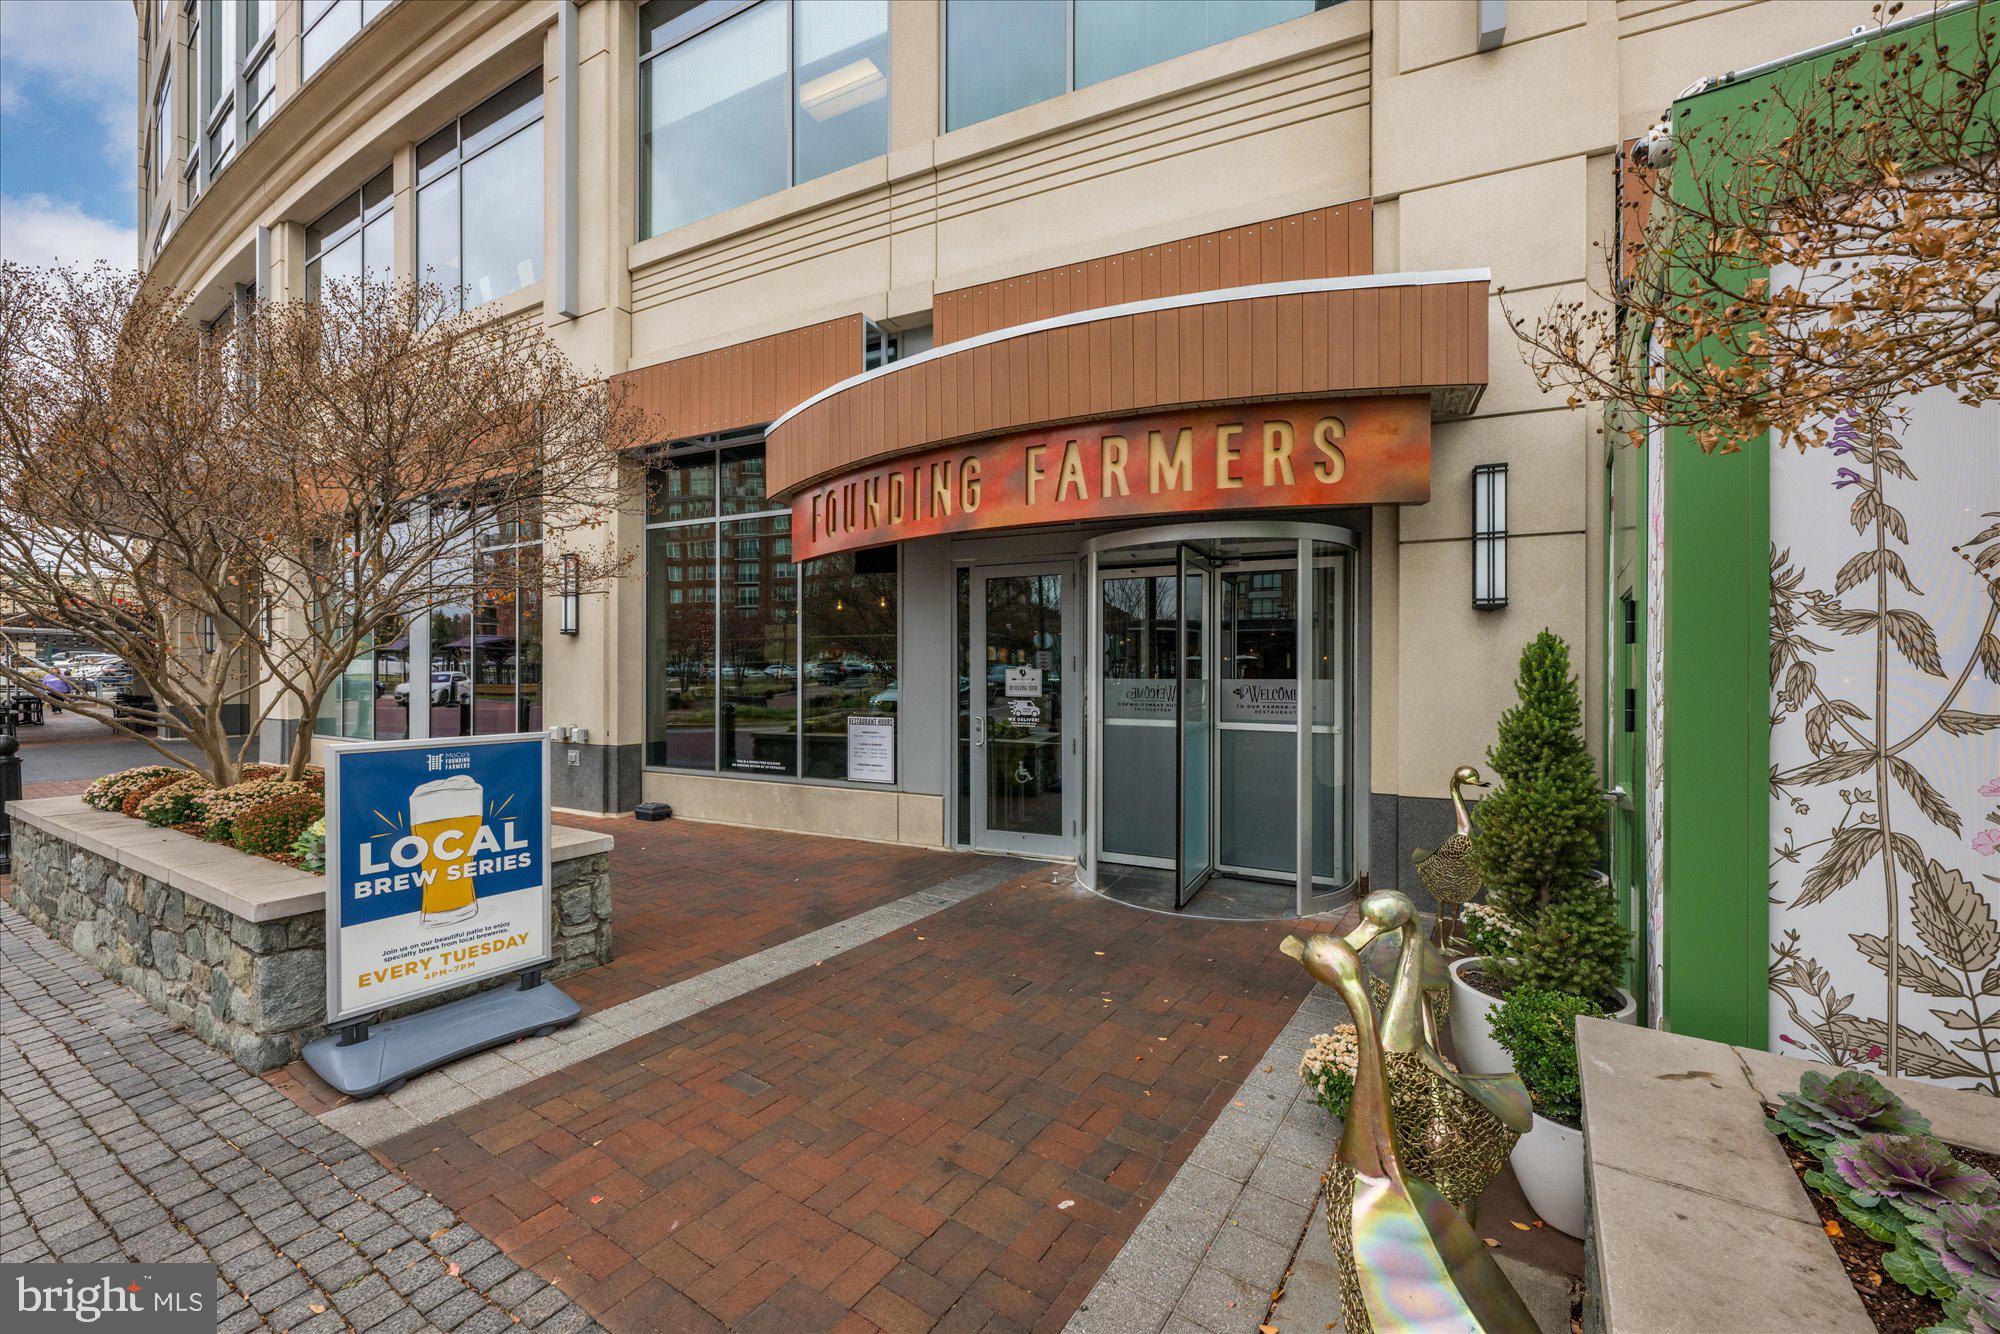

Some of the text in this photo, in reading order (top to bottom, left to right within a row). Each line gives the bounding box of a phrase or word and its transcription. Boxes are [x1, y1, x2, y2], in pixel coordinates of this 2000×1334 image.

[812, 416, 1347, 543] FOUNDING FARMERS
[848, 717, 894, 727] RESTAURANT HOURS
[359, 821, 529, 876] LOCAL
[354, 852, 532, 900] BREW SERIES
[358, 932, 530, 989] EVERY TUESDAY
[382, 948, 398, 957] Join
[434, 931, 465, 944] beautiful
[466, 926, 484, 937] patio
[484, 924, 492, 932] to
[493, 921, 511, 931] enjoy
[383, 928, 509, 963] specialty brews from local breweries.
